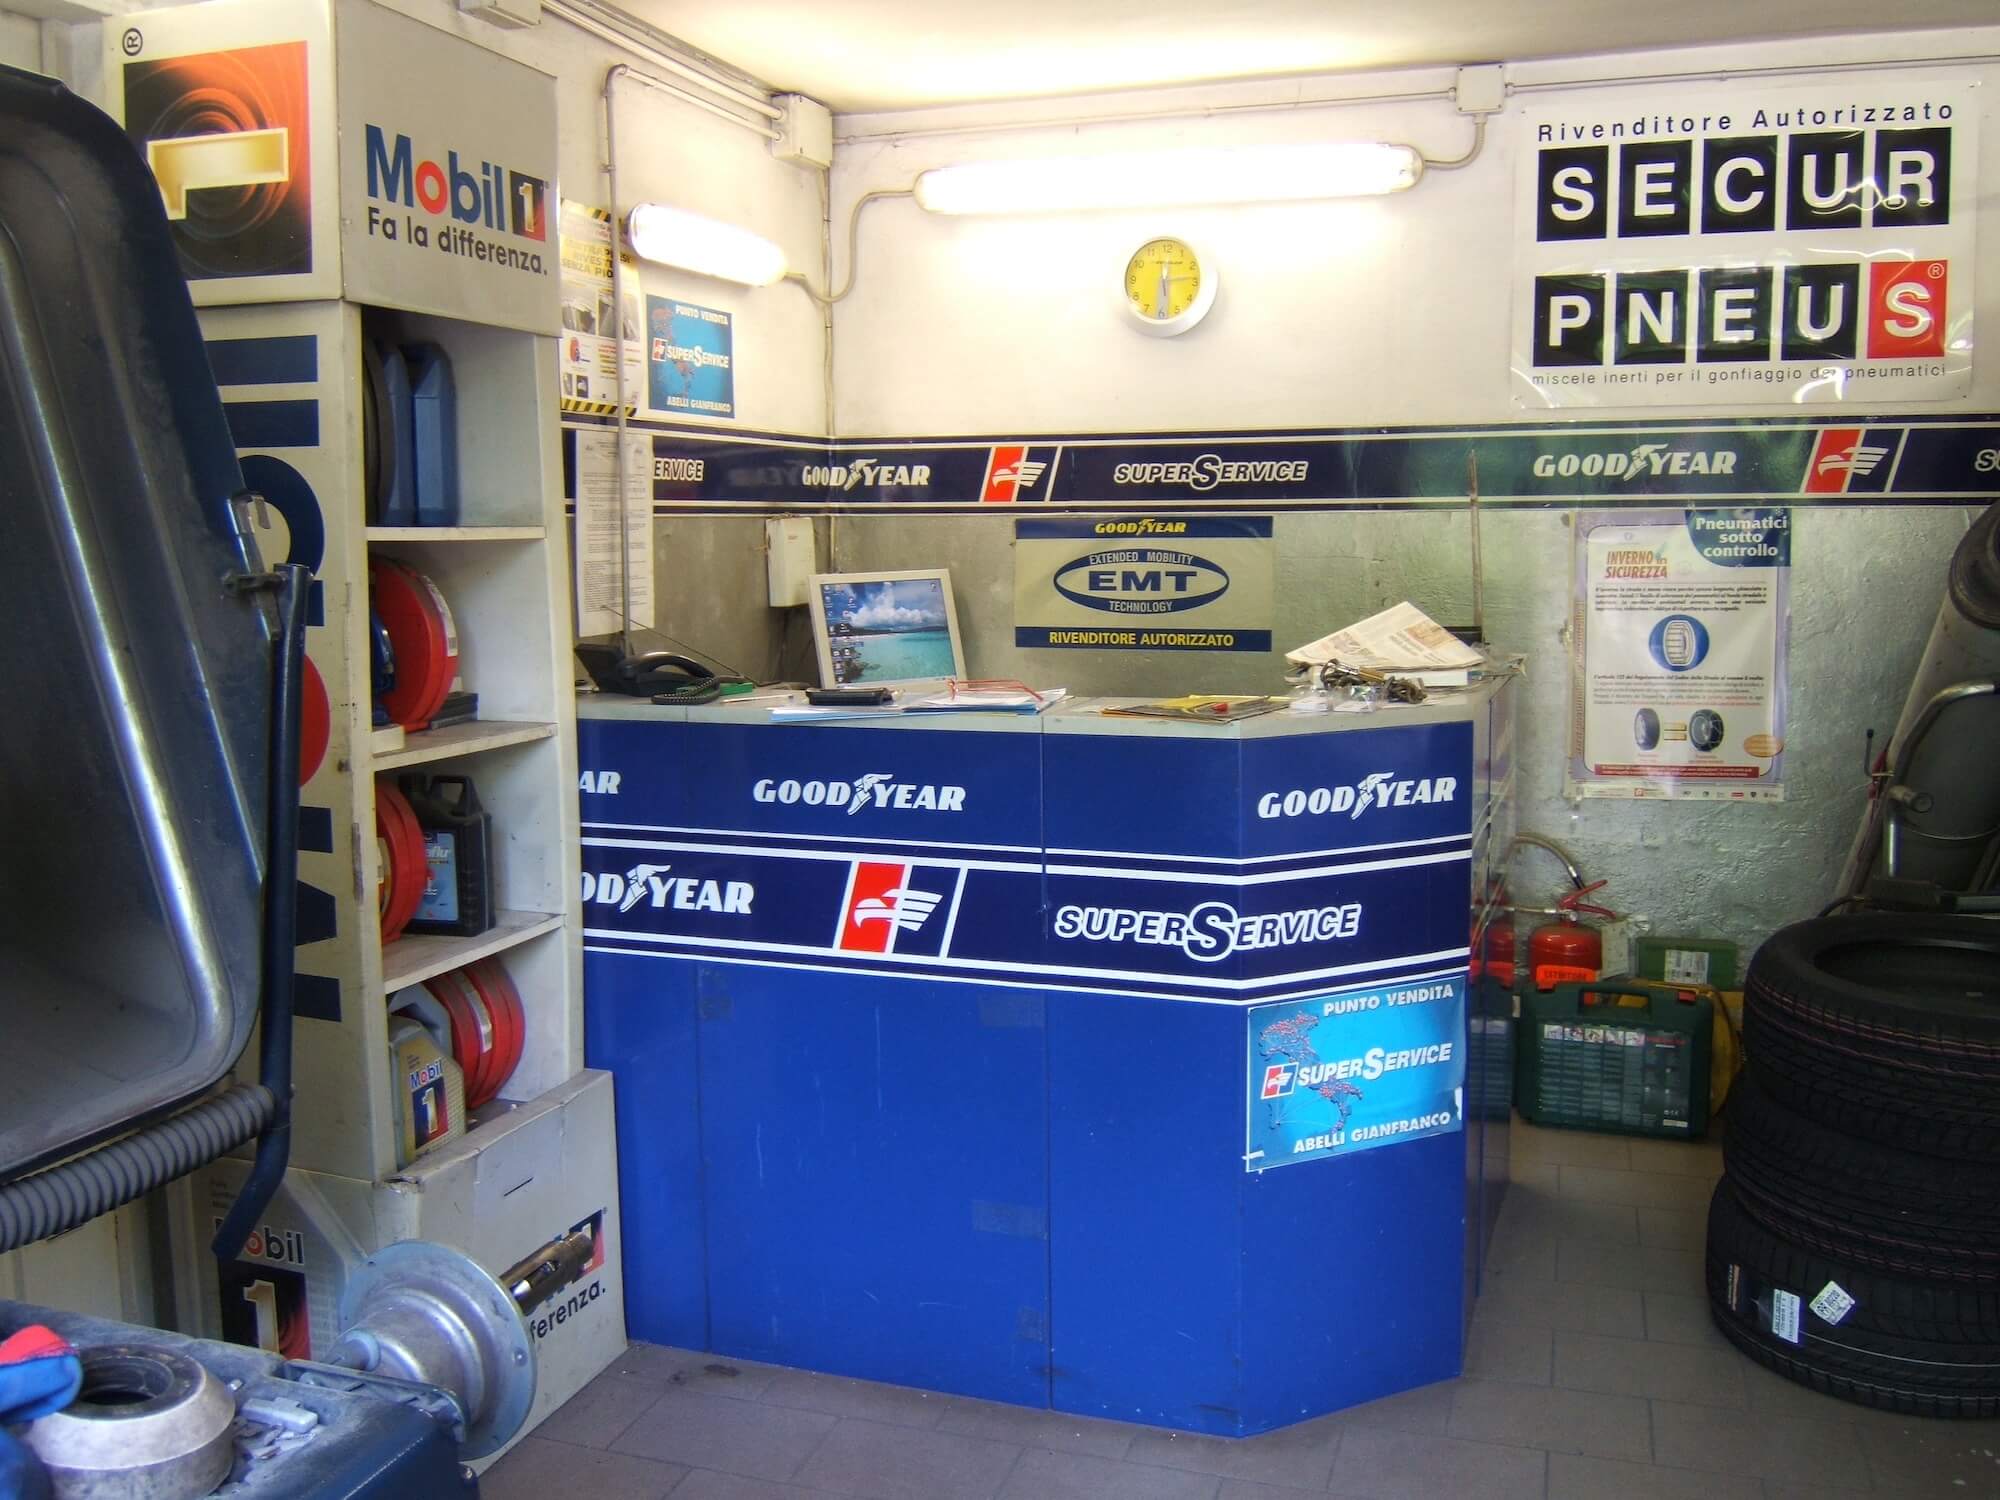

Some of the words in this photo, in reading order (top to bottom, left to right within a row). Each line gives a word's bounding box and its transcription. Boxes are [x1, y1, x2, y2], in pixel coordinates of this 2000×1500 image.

[1538, 111, 1732, 142] Rivenditore
[1752, 102, 1953, 129] Autorizzato
[365, 123, 506, 231] Mobil
[1551, 150, 1935, 221] SECUR
[368, 207, 398, 240] Fa
[407, 213, 429, 249] la
[438, 224, 548, 276] differenza.
[1549, 282, 1932, 346] PNEUS
[1532, 373, 1596, 386] miscele
[1603, 370, 1648, 384] inerti
[1656, 371, 1684, 384] per
[1690, 369, 1700, 382] il
[1708, 368, 1802, 384] gonfiaggio
[1846, 366, 1947, 381] pneumatici
[653, 457, 704, 482] ERVICE
[1695, 515, 1788, 530] Pneumatici
[1719, 532, 1764, 543] sotto
[1089, 551, 1139, 566] EXTENDED
[1146, 551, 1194, 566] MOBILITY
[1606, 550, 1654, 565] INVERNO
[1703, 544, 1779, 557] controllo
[1088, 571, 1198, 592] EMT
[1605, 565, 1668, 579] SICUREZZA
[1109, 601, 1174, 613] TECHNOLOGY
[1049, 631, 1137, 646] RIVENDITORE
[1140, 633, 1235, 647] AUTORIZZATO
[1323, 995, 1380, 1017] PUNTO
[1386, 984, 1453, 1007] VENDITA
[410, 1059, 443, 1088] Mobil
[1293, 1130, 1345, 1154] ABELLI
[1351, 1112, 1451, 1143] GIANFRANCO
[529, 1281, 606, 1343] ferenza.
